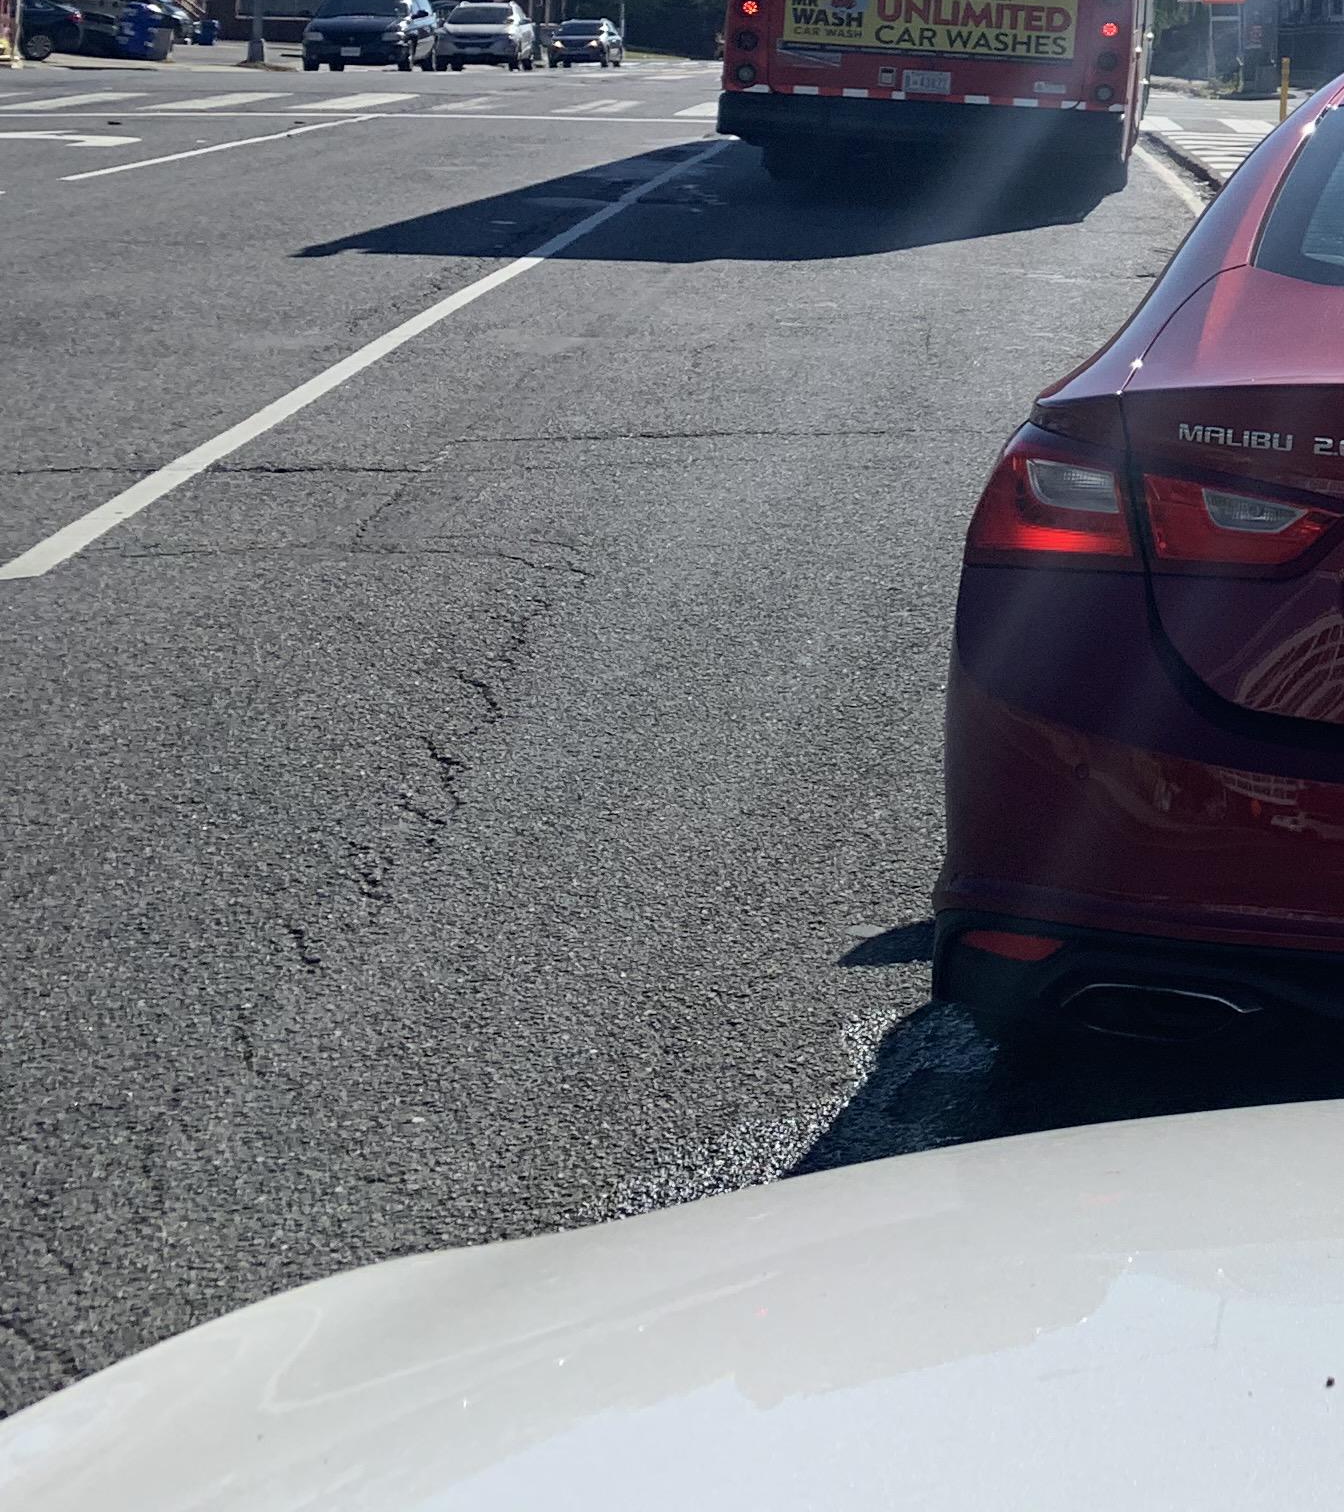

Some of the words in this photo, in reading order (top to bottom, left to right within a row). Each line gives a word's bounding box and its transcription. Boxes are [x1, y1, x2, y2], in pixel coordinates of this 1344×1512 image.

[792, 7, 863, 28] WASH
[794, 26, 820, 36] CAR
[825, 28, 863, 39] WASH
[875, 25, 937, 48] CAR
[946, 29, 1067, 56] WASHES
[1178, 423, 1294, 452] MALIBU
